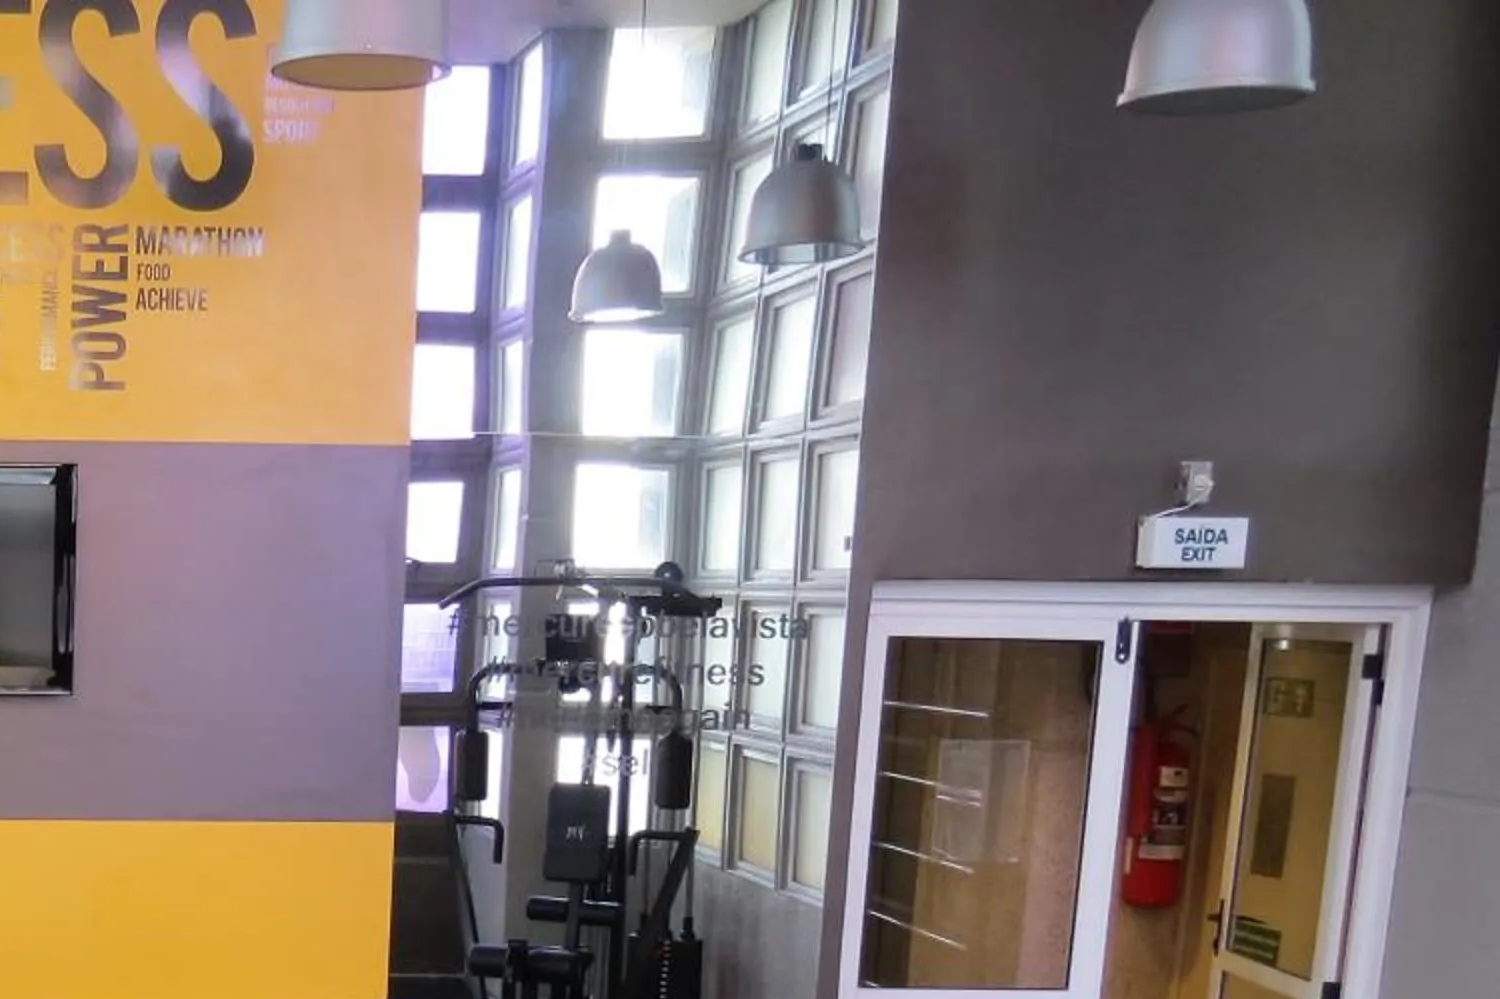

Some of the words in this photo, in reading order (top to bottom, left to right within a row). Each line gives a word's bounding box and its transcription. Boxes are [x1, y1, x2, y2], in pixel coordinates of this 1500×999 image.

[136, 225, 263, 257] MARATHON
[137, 263, 171, 281] FOOD
[69, 223, 129, 391] POWER
[136, 288, 208, 311] ACHIEVE
[1181, 547, 1216, 561] EXIT
